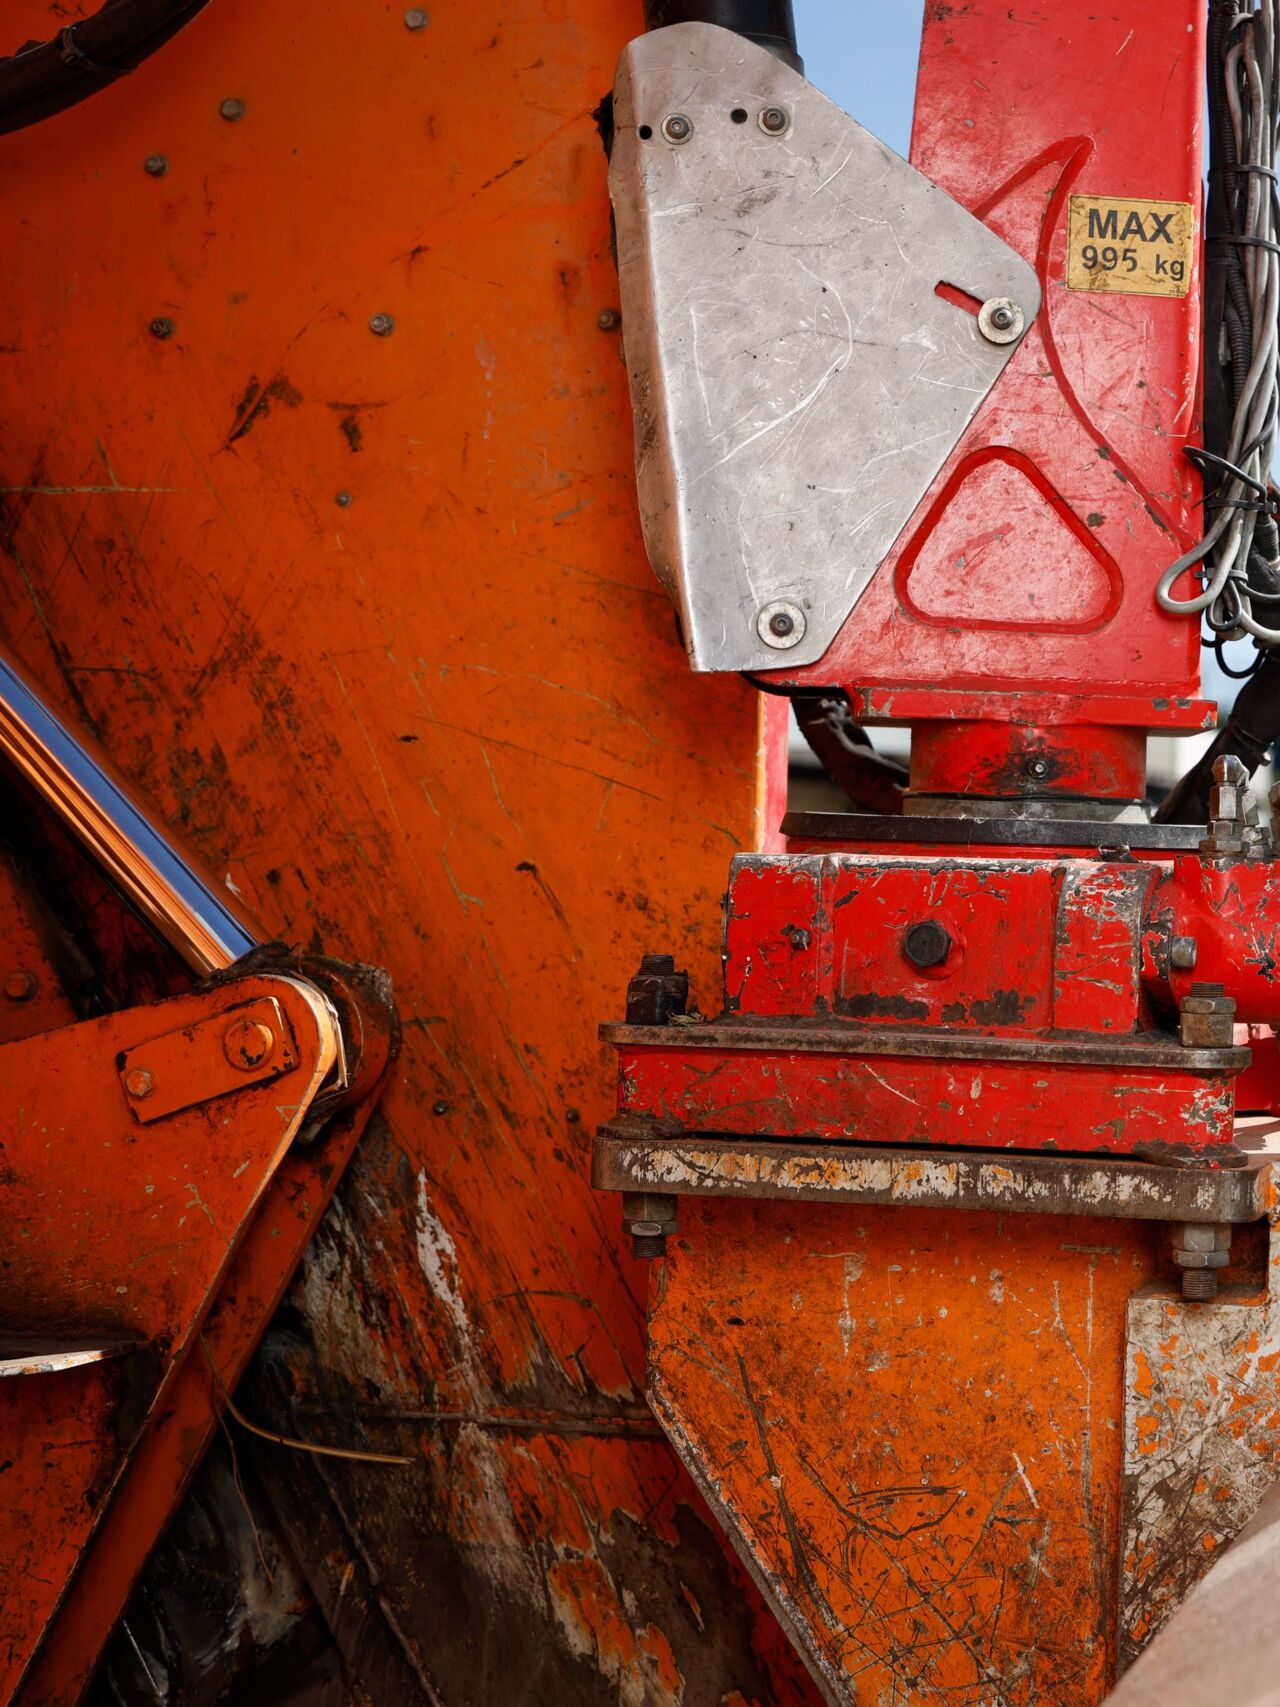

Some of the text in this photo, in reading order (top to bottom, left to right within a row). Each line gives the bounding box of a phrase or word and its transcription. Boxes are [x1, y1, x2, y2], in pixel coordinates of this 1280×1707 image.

[1088, 208, 1174, 244] MAX
[1081, 245, 1185, 281] 995 kg
